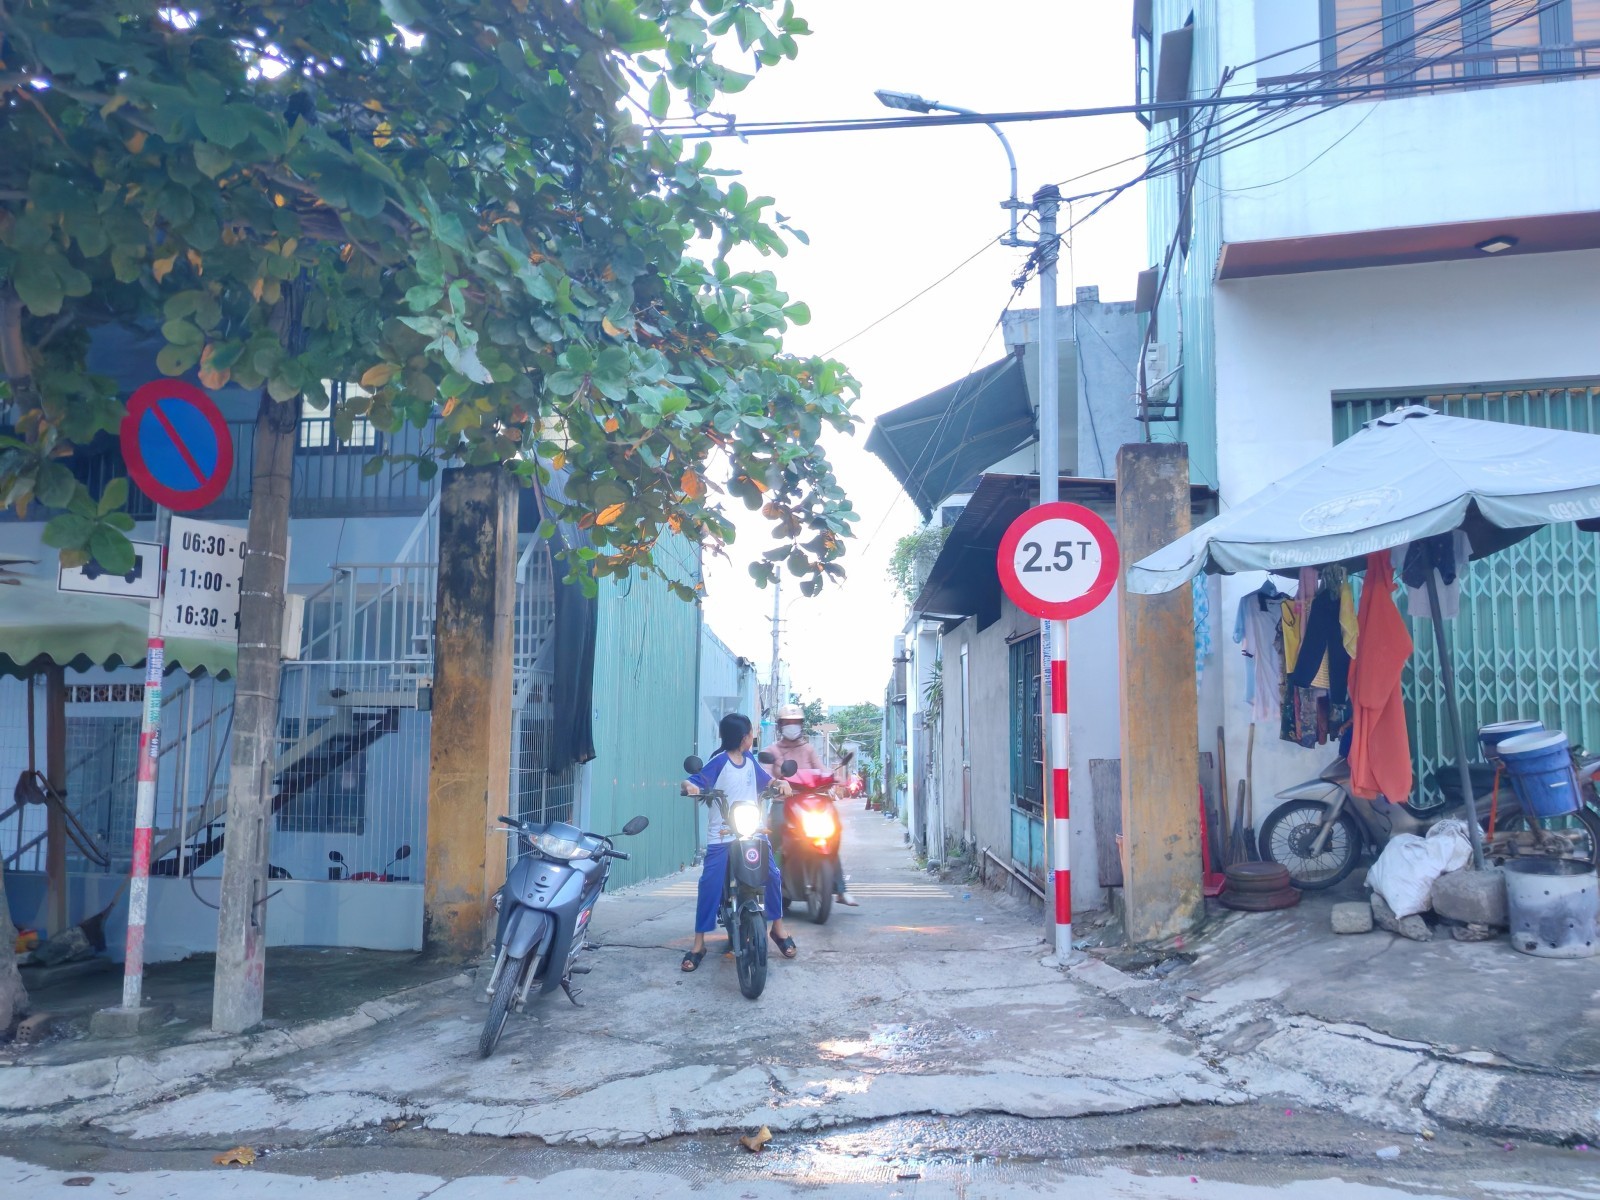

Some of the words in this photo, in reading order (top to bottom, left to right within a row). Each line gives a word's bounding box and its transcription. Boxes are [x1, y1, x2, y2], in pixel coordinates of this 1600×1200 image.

[1548, 500, 1591, 520] 0931
[182, 531, 226, 557] 06:30
[1269, 529, 1410, 566] CaPheDongXanh.com
[180, 567, 223, 592] 11:00
[176, 604, 219, 628] 16:30
